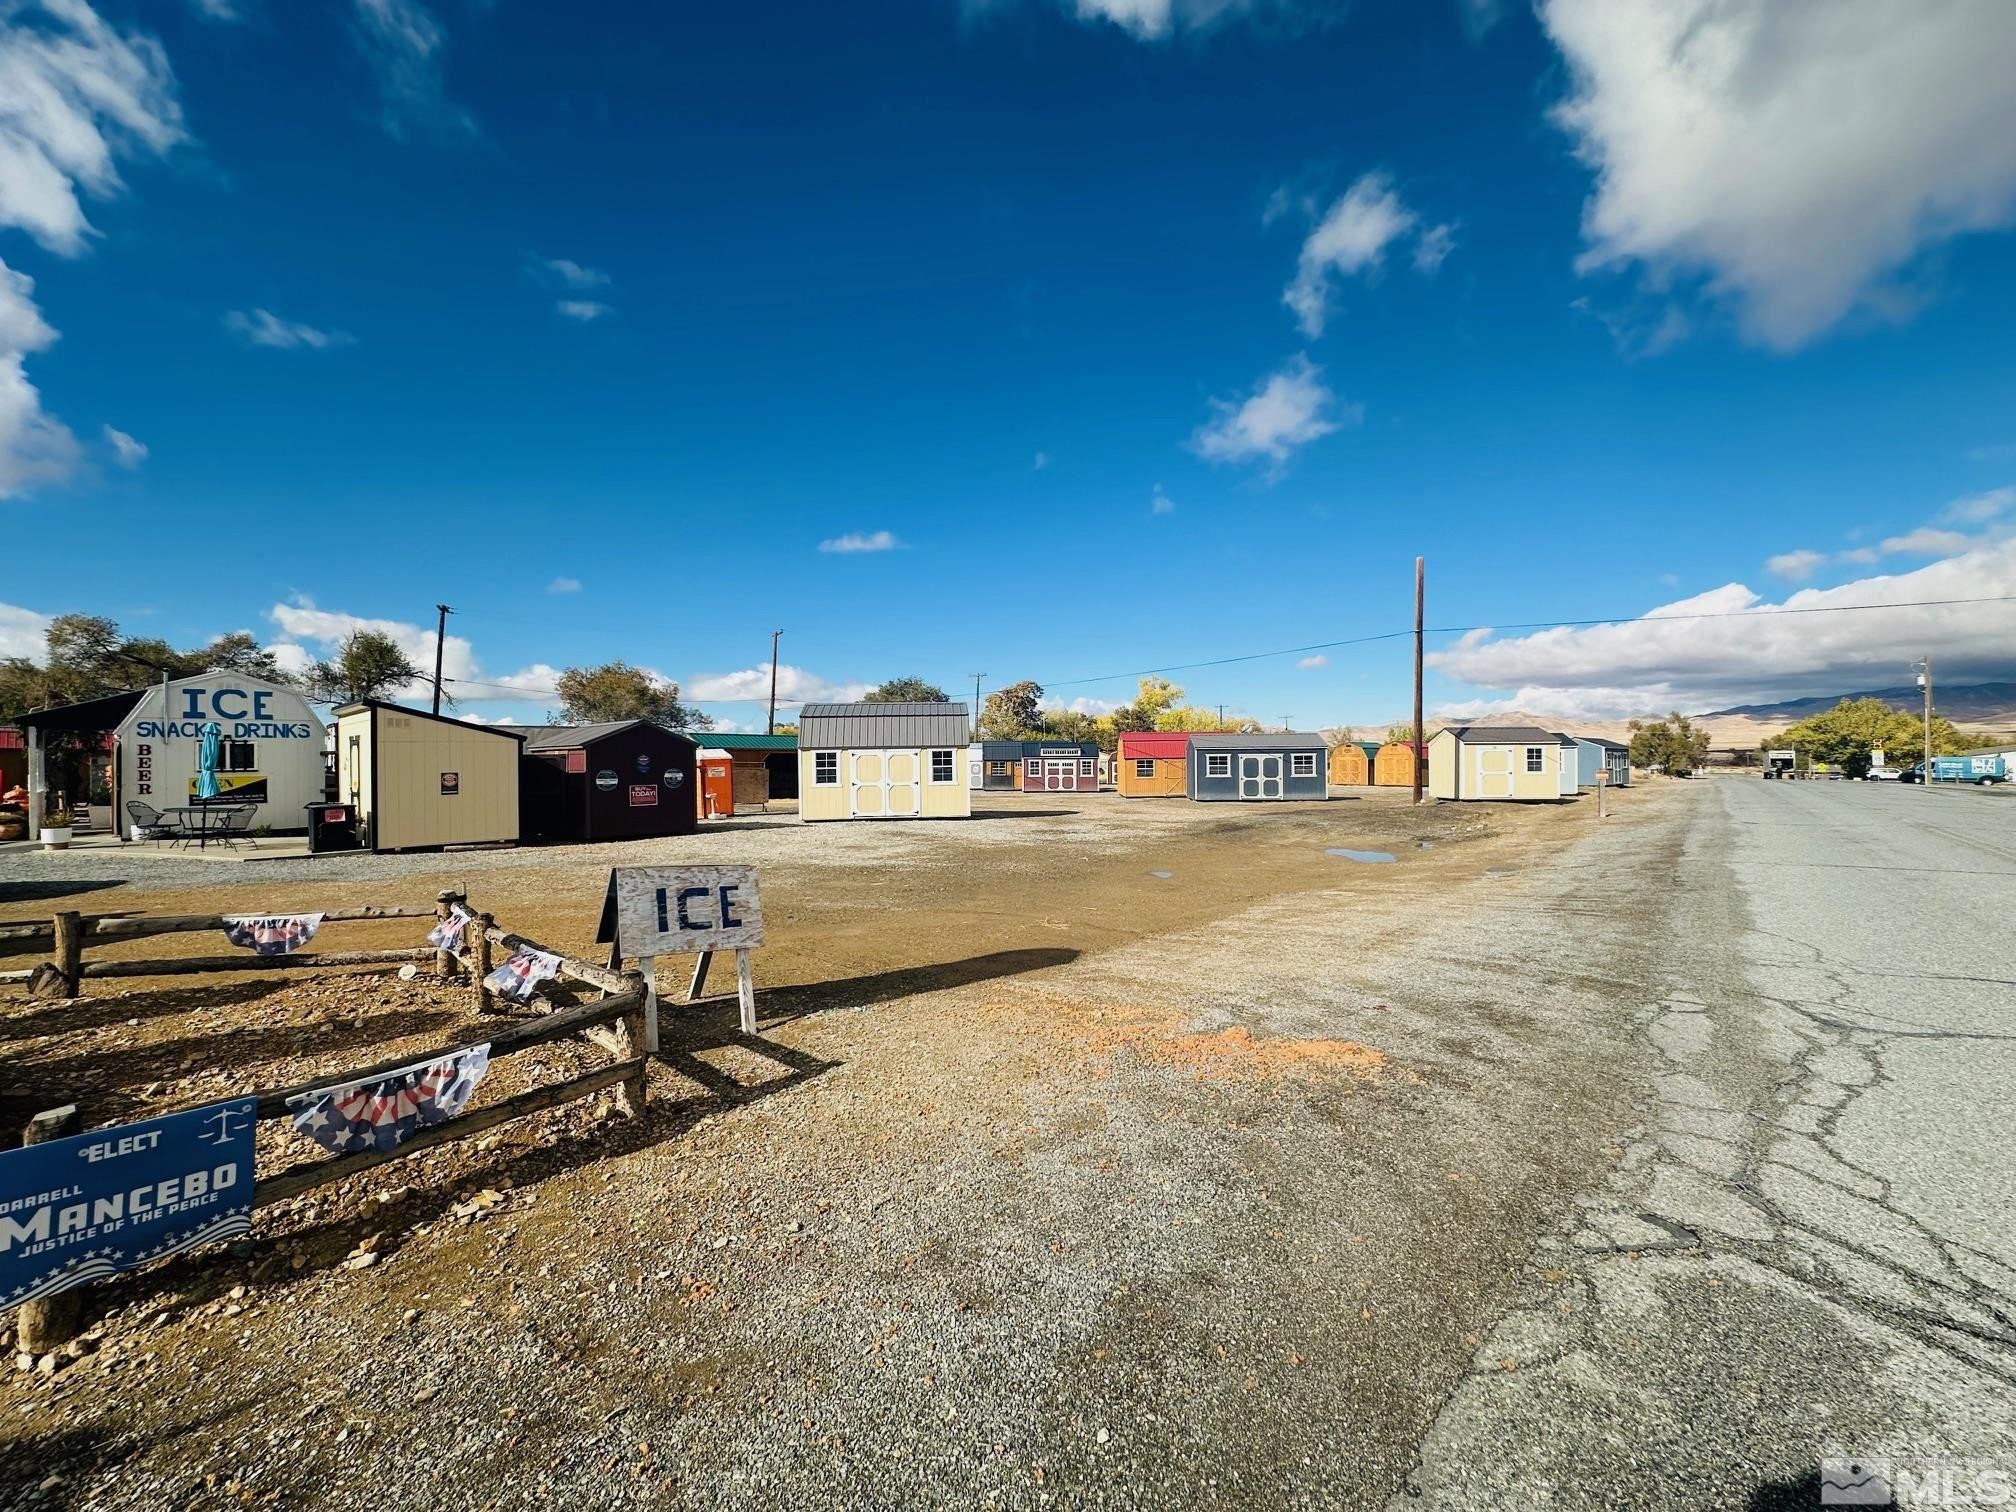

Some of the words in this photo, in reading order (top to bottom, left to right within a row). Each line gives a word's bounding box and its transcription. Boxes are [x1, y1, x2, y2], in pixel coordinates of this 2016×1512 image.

[182, 688, 274, 720] ICE
[234, 723, 310, 739] DRINKS
[137, 744, 152, 795] BEER
[656, 885, 743, 933] ICE
[88, 1130, 162, 1163] ELECT
[0, 1185, 83, 1214] DARRELL
[0, 1163, 237, 1252] MANCEBO
[18, 1228, 96, 1259] JUSTICE
[103, 1219, 125, 1234] OF
[131, 1205, 163, 1226] THE
[169, 1191, 218, 1214] PEACE
